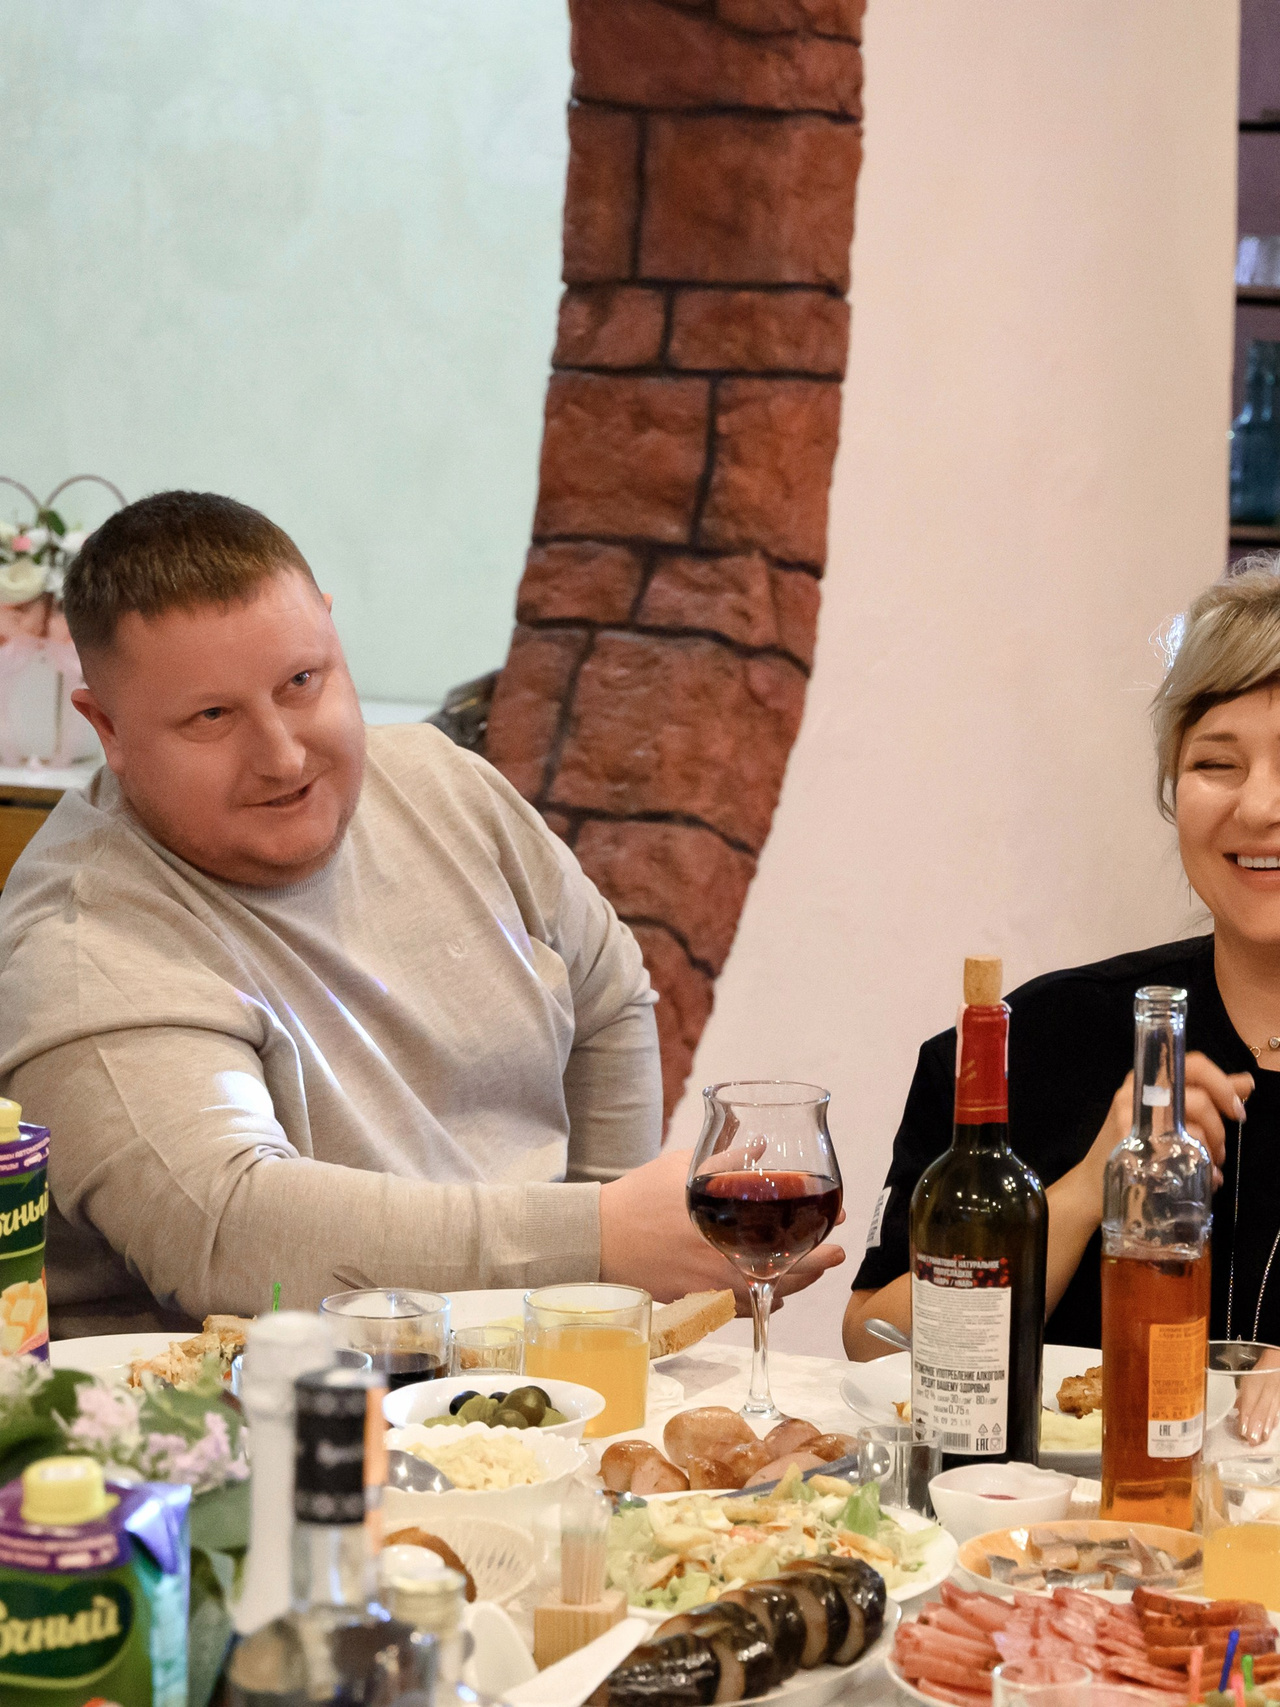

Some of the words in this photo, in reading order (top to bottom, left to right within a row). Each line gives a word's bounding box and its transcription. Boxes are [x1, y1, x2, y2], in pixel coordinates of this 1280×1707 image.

[958, 1260, 1000, 1269] НАТУРАЛЬНОЕ
[933, 1266, 973, 1278] ПОЛУСЛАДКОЕ
[936, 1368, 975, 1381] УПОТРЕБЛЕНИЕ
[976, 1370, 1005, 1381] АЛКОГОЛЯ
[936, 1379, 958, 1391] ВАШЕМУ
[959, 1383, 990, 1393] ЗДОРОВЬЮ
